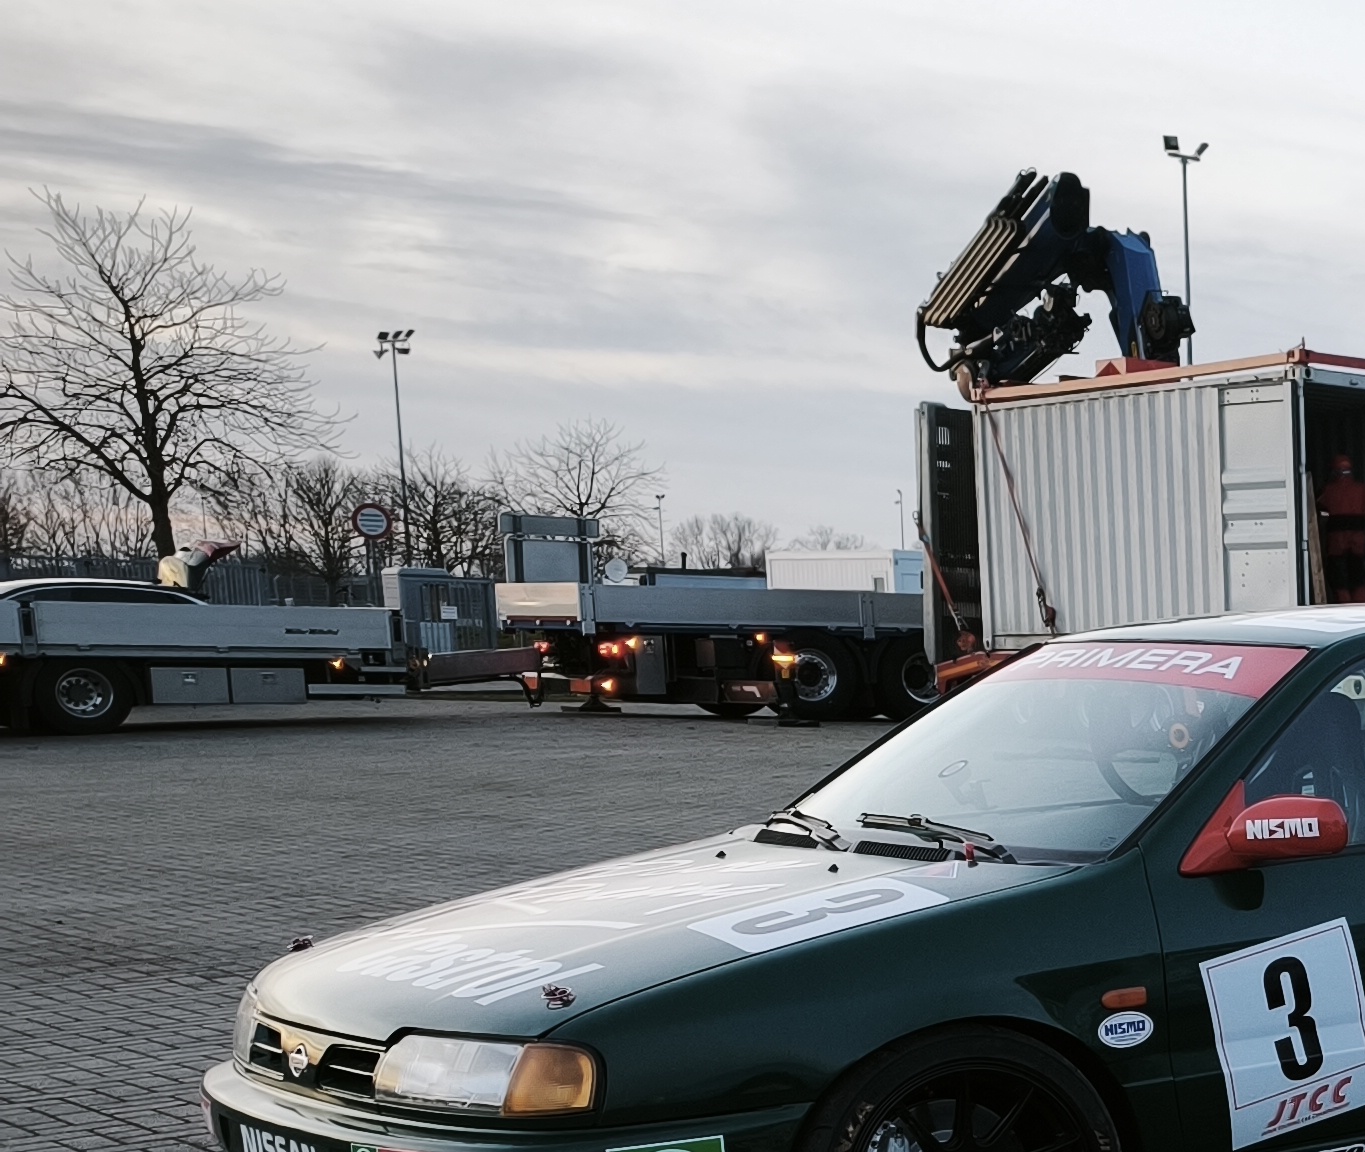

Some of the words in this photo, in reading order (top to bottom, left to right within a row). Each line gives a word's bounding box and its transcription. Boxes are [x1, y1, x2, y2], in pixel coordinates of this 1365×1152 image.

[1012, 646, 1244, 680] PRIMERA
[1245, 817, 1320, 841] NISMO
[731, 887, 906, 936] 3
[1104, 1019, 1146, 1037] NISMO
[1263, 955, 1324, 1081] 3
[1265, 1075, 1353, 1129] JTCC
